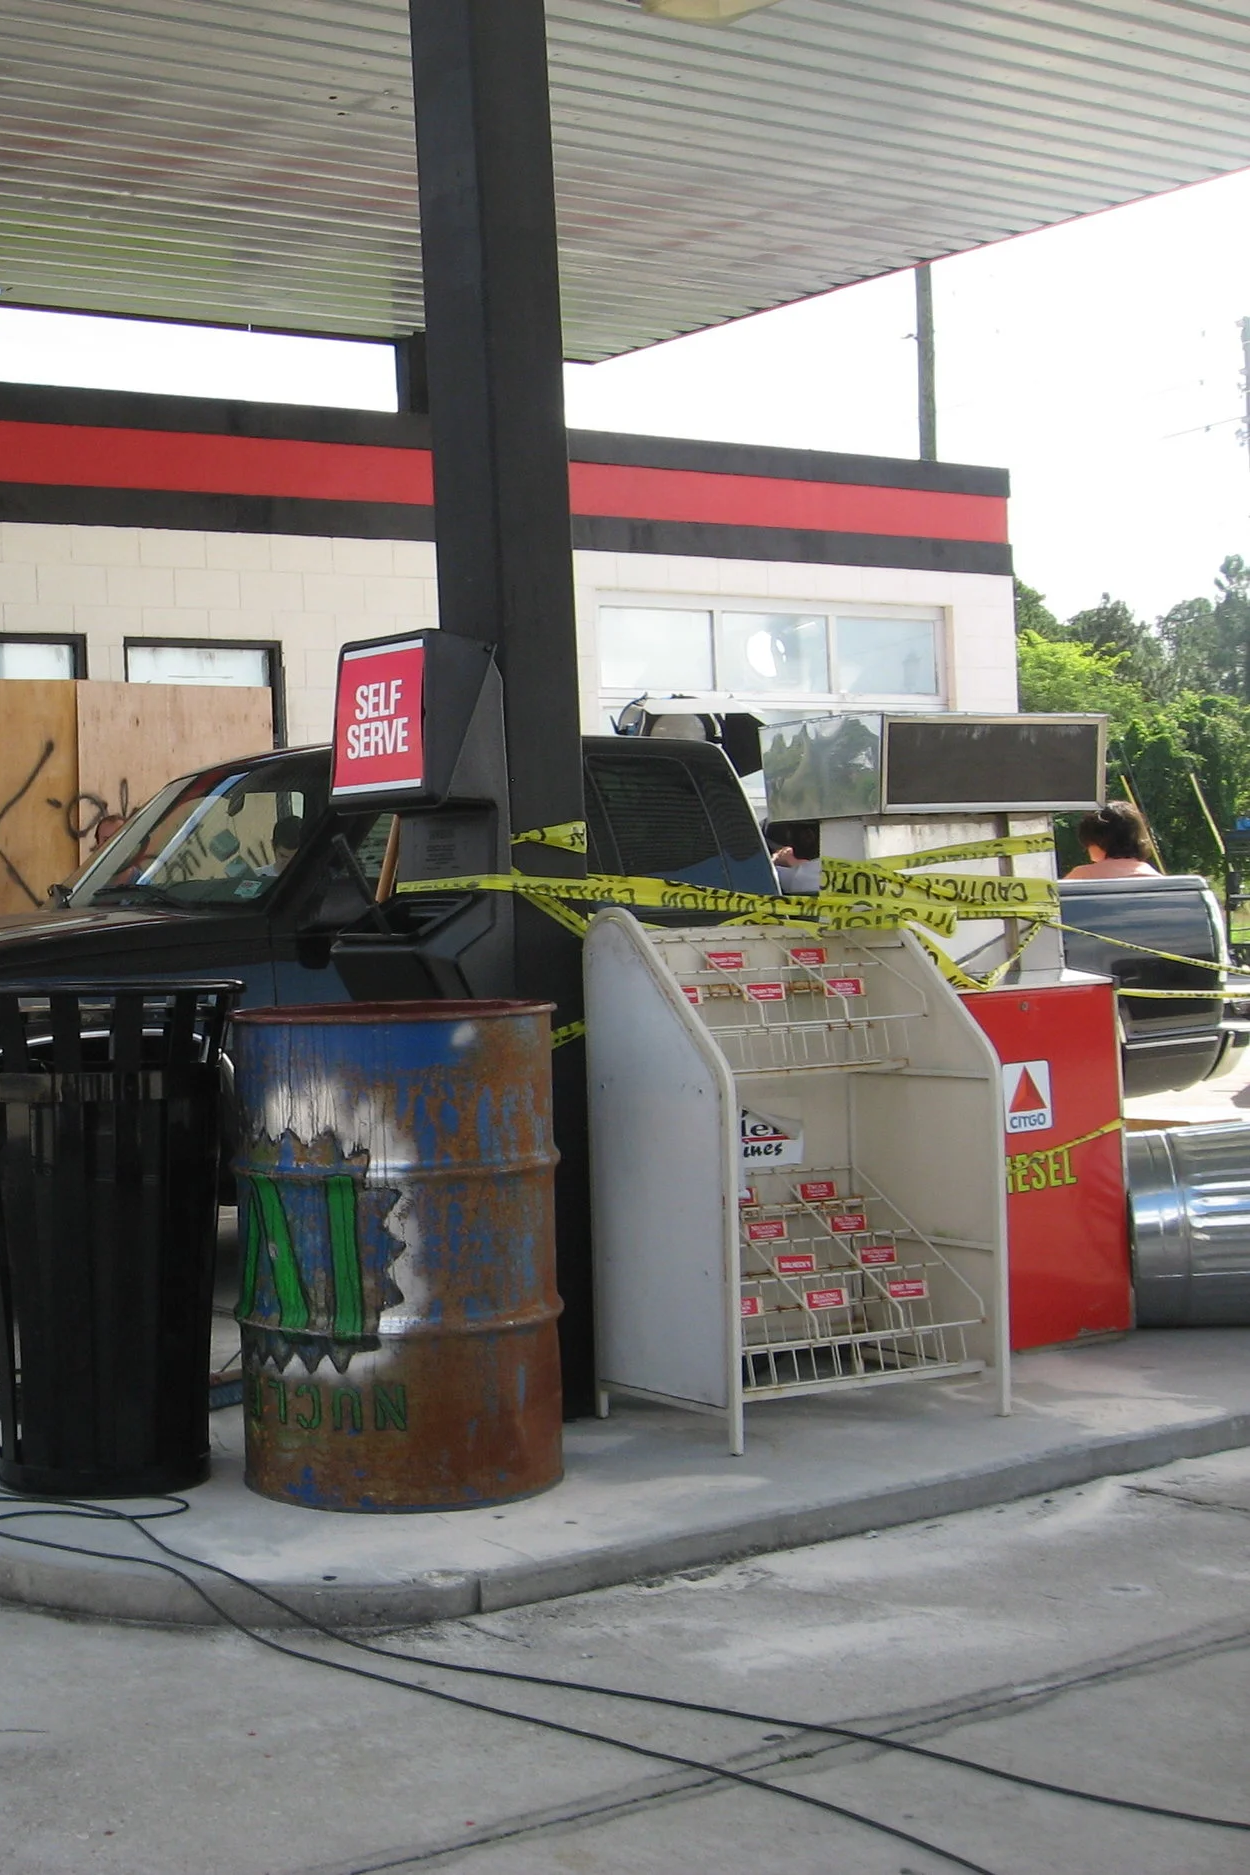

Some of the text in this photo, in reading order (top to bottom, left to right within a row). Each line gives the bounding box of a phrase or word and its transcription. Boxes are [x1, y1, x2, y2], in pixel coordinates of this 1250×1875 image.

[355, 679, 403, 721] SELF
[347, 717, 409, 760] SERVE
[819, 869, 905, 898] CAUTIO
[1010, 1113, 1046, 1129] CITGO
[1006, 1150, 1078, 1194] IESEL
